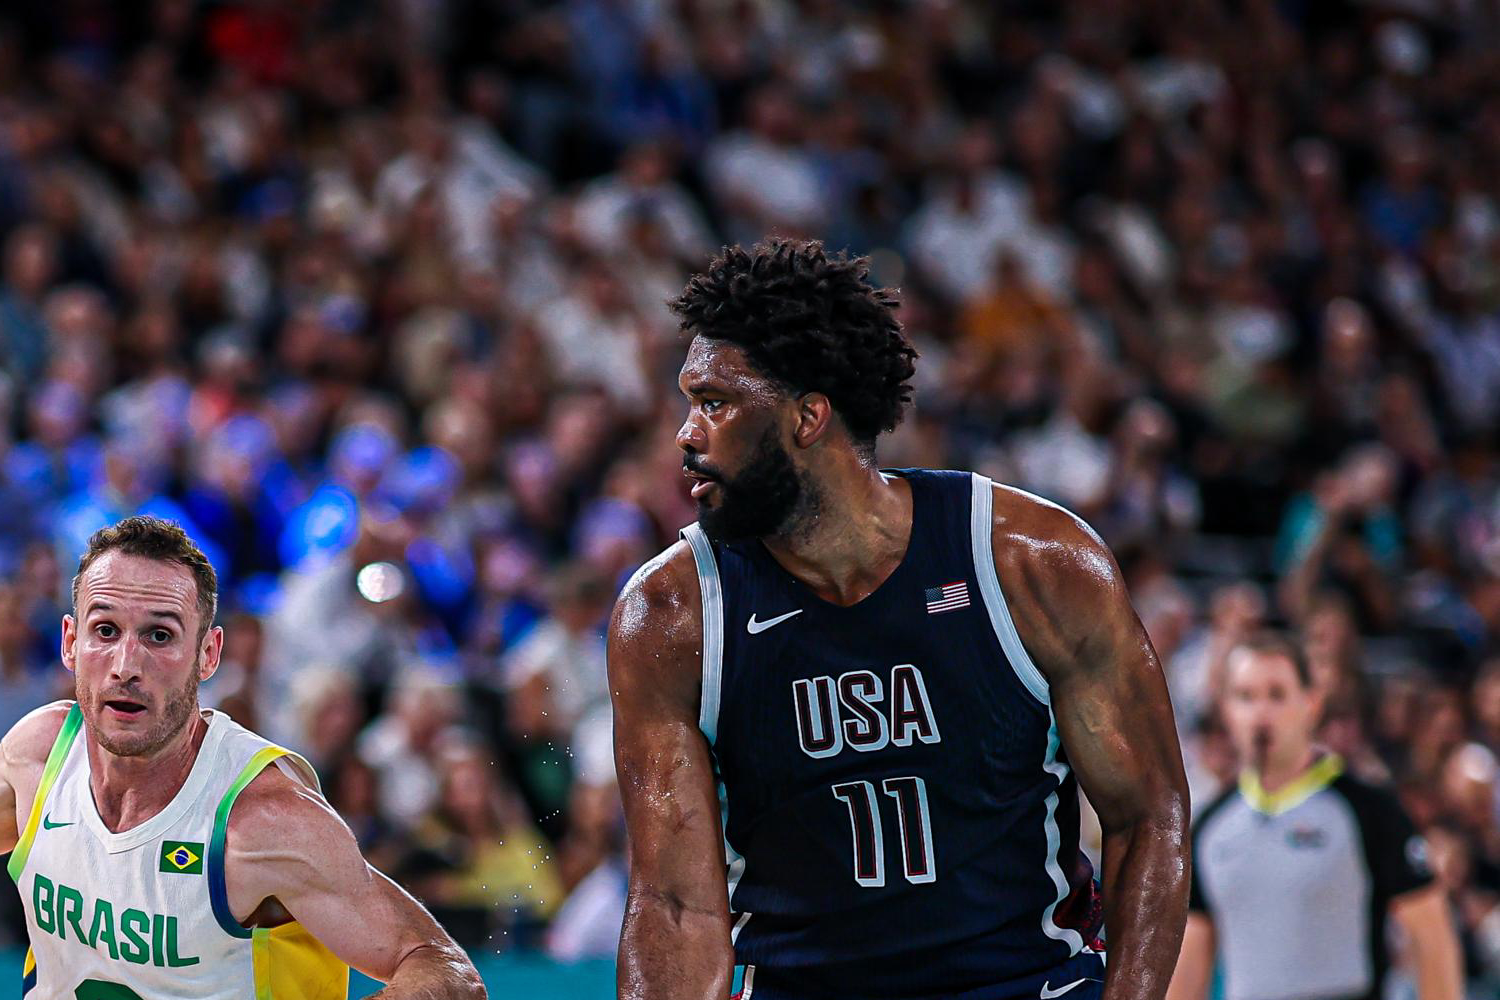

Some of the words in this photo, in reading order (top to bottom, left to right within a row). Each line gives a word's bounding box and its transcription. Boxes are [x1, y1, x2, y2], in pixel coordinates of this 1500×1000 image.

[792, 664, 941, 759] USA
[832, 777, 936, 887] 11
[33, 873, 200, 968] BRASIL
